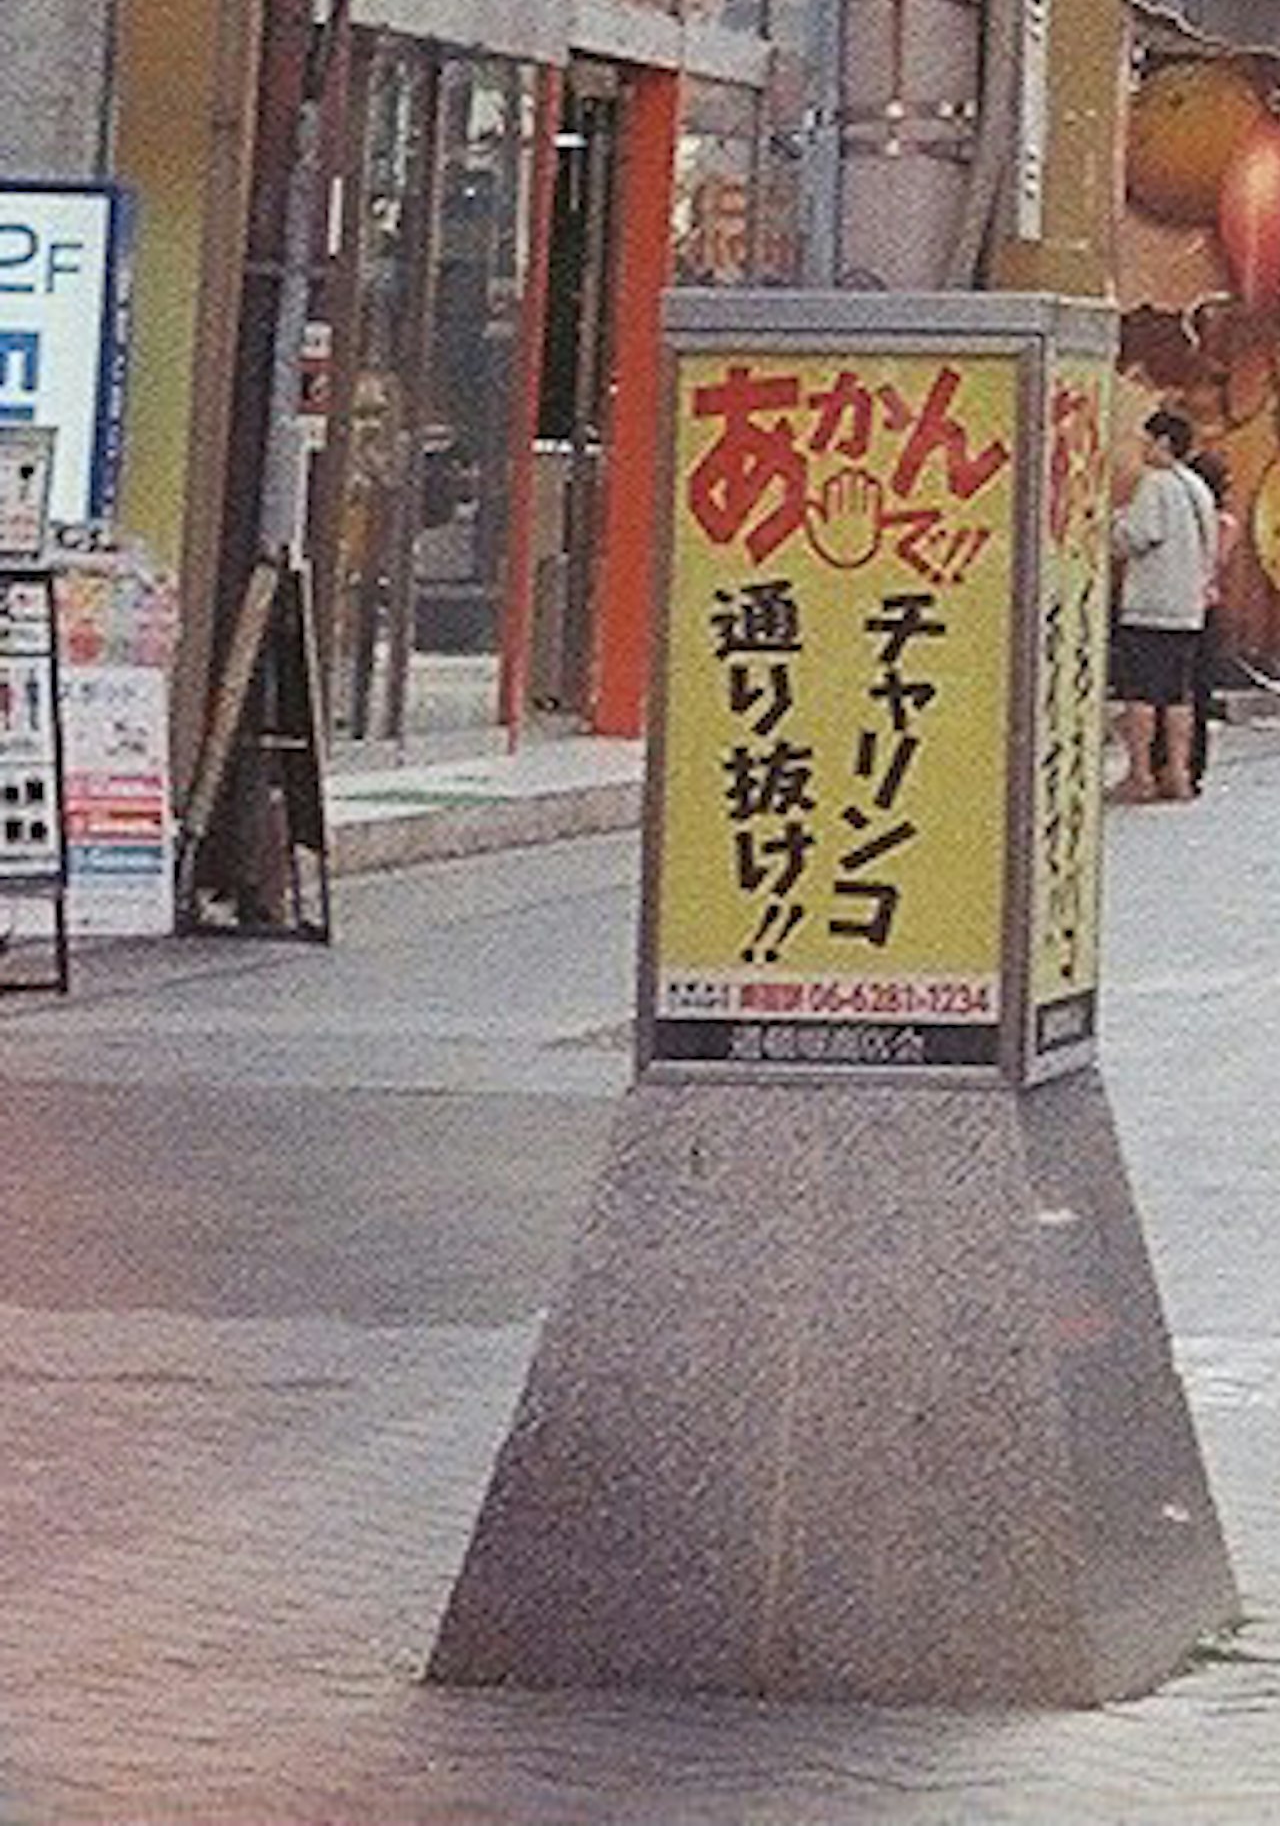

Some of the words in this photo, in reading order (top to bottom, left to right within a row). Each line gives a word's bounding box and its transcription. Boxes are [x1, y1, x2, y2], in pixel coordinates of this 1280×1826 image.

[688, 364, 1008, 564] あかん
[828, 593, 946, 949] チャリンコ
